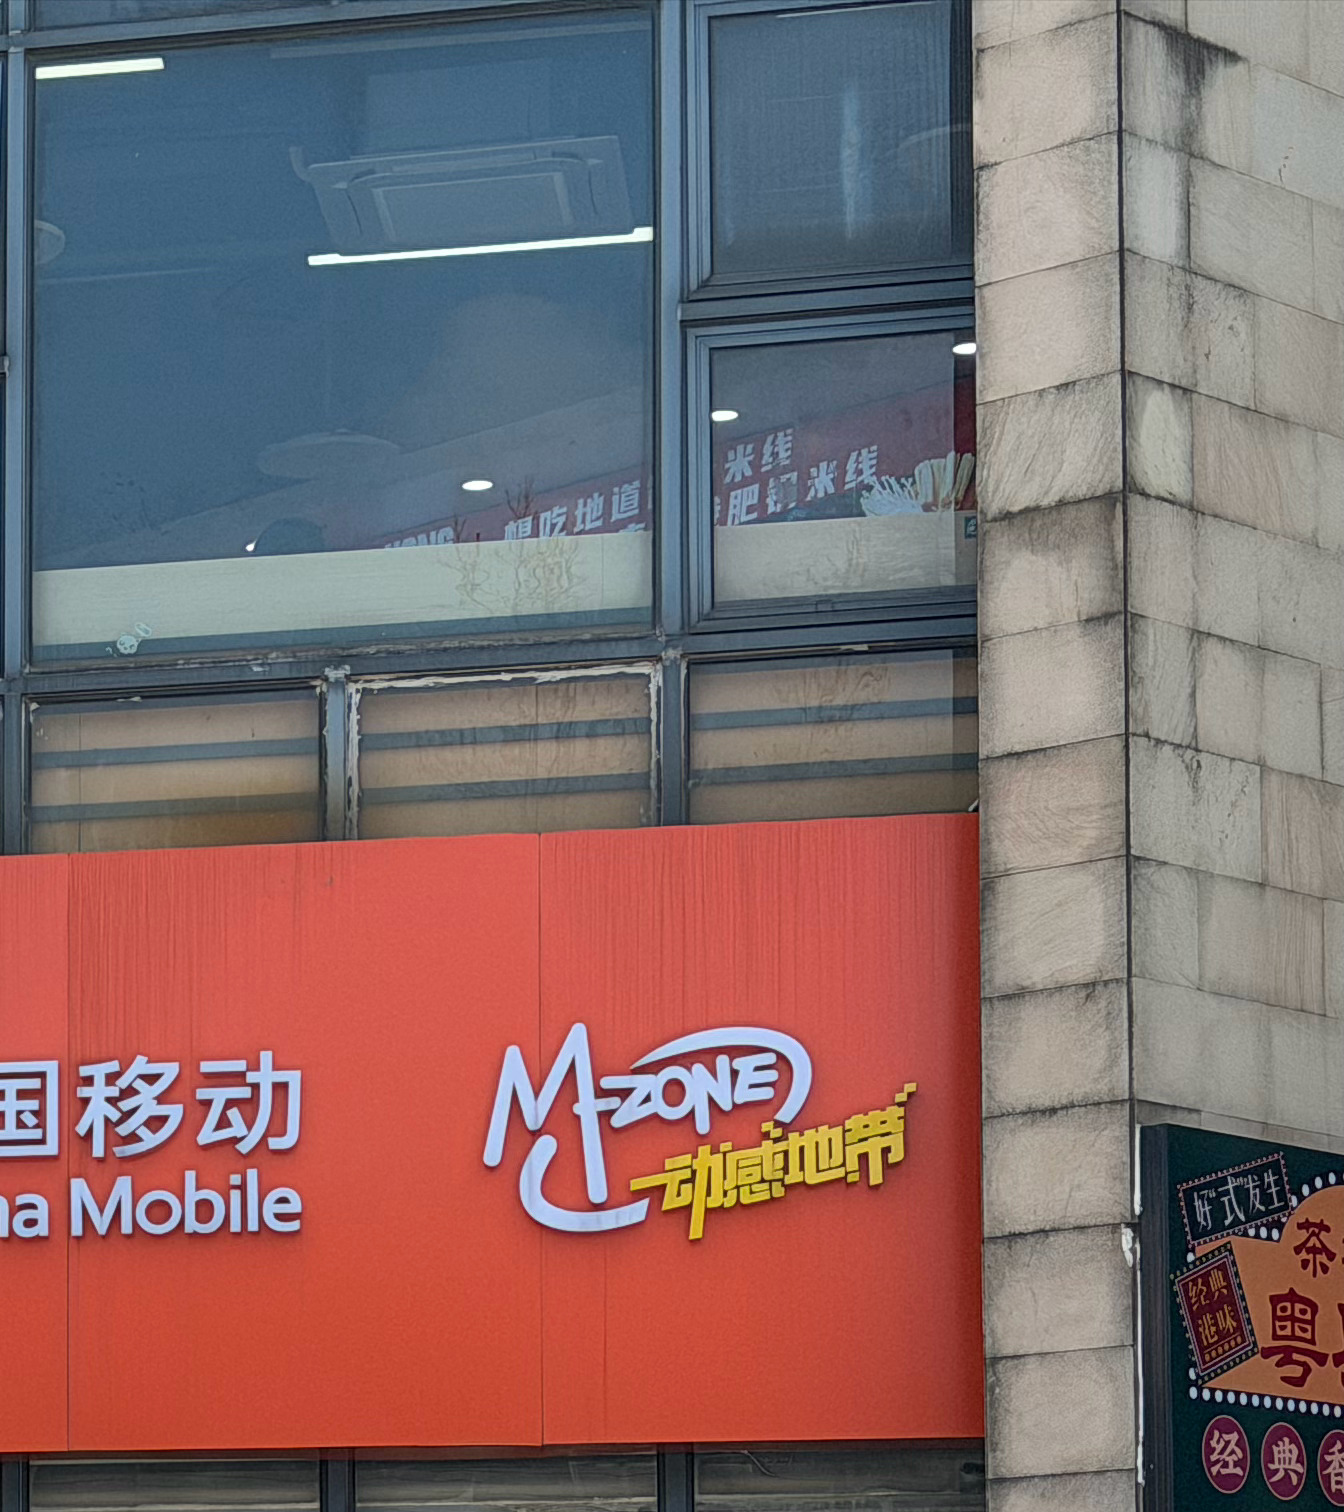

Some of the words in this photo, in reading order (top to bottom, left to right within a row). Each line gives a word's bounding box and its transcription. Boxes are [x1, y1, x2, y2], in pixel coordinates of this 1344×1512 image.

[505, 478, 652, 541] 想吃地道
[630, 1082, 917, 1240] 动感地带
[69, 1168, 302, 1239] Mobile
[1293, 1217, 1344, 1278] 茶
[1261, 1287, 1344, 1388] 粤
